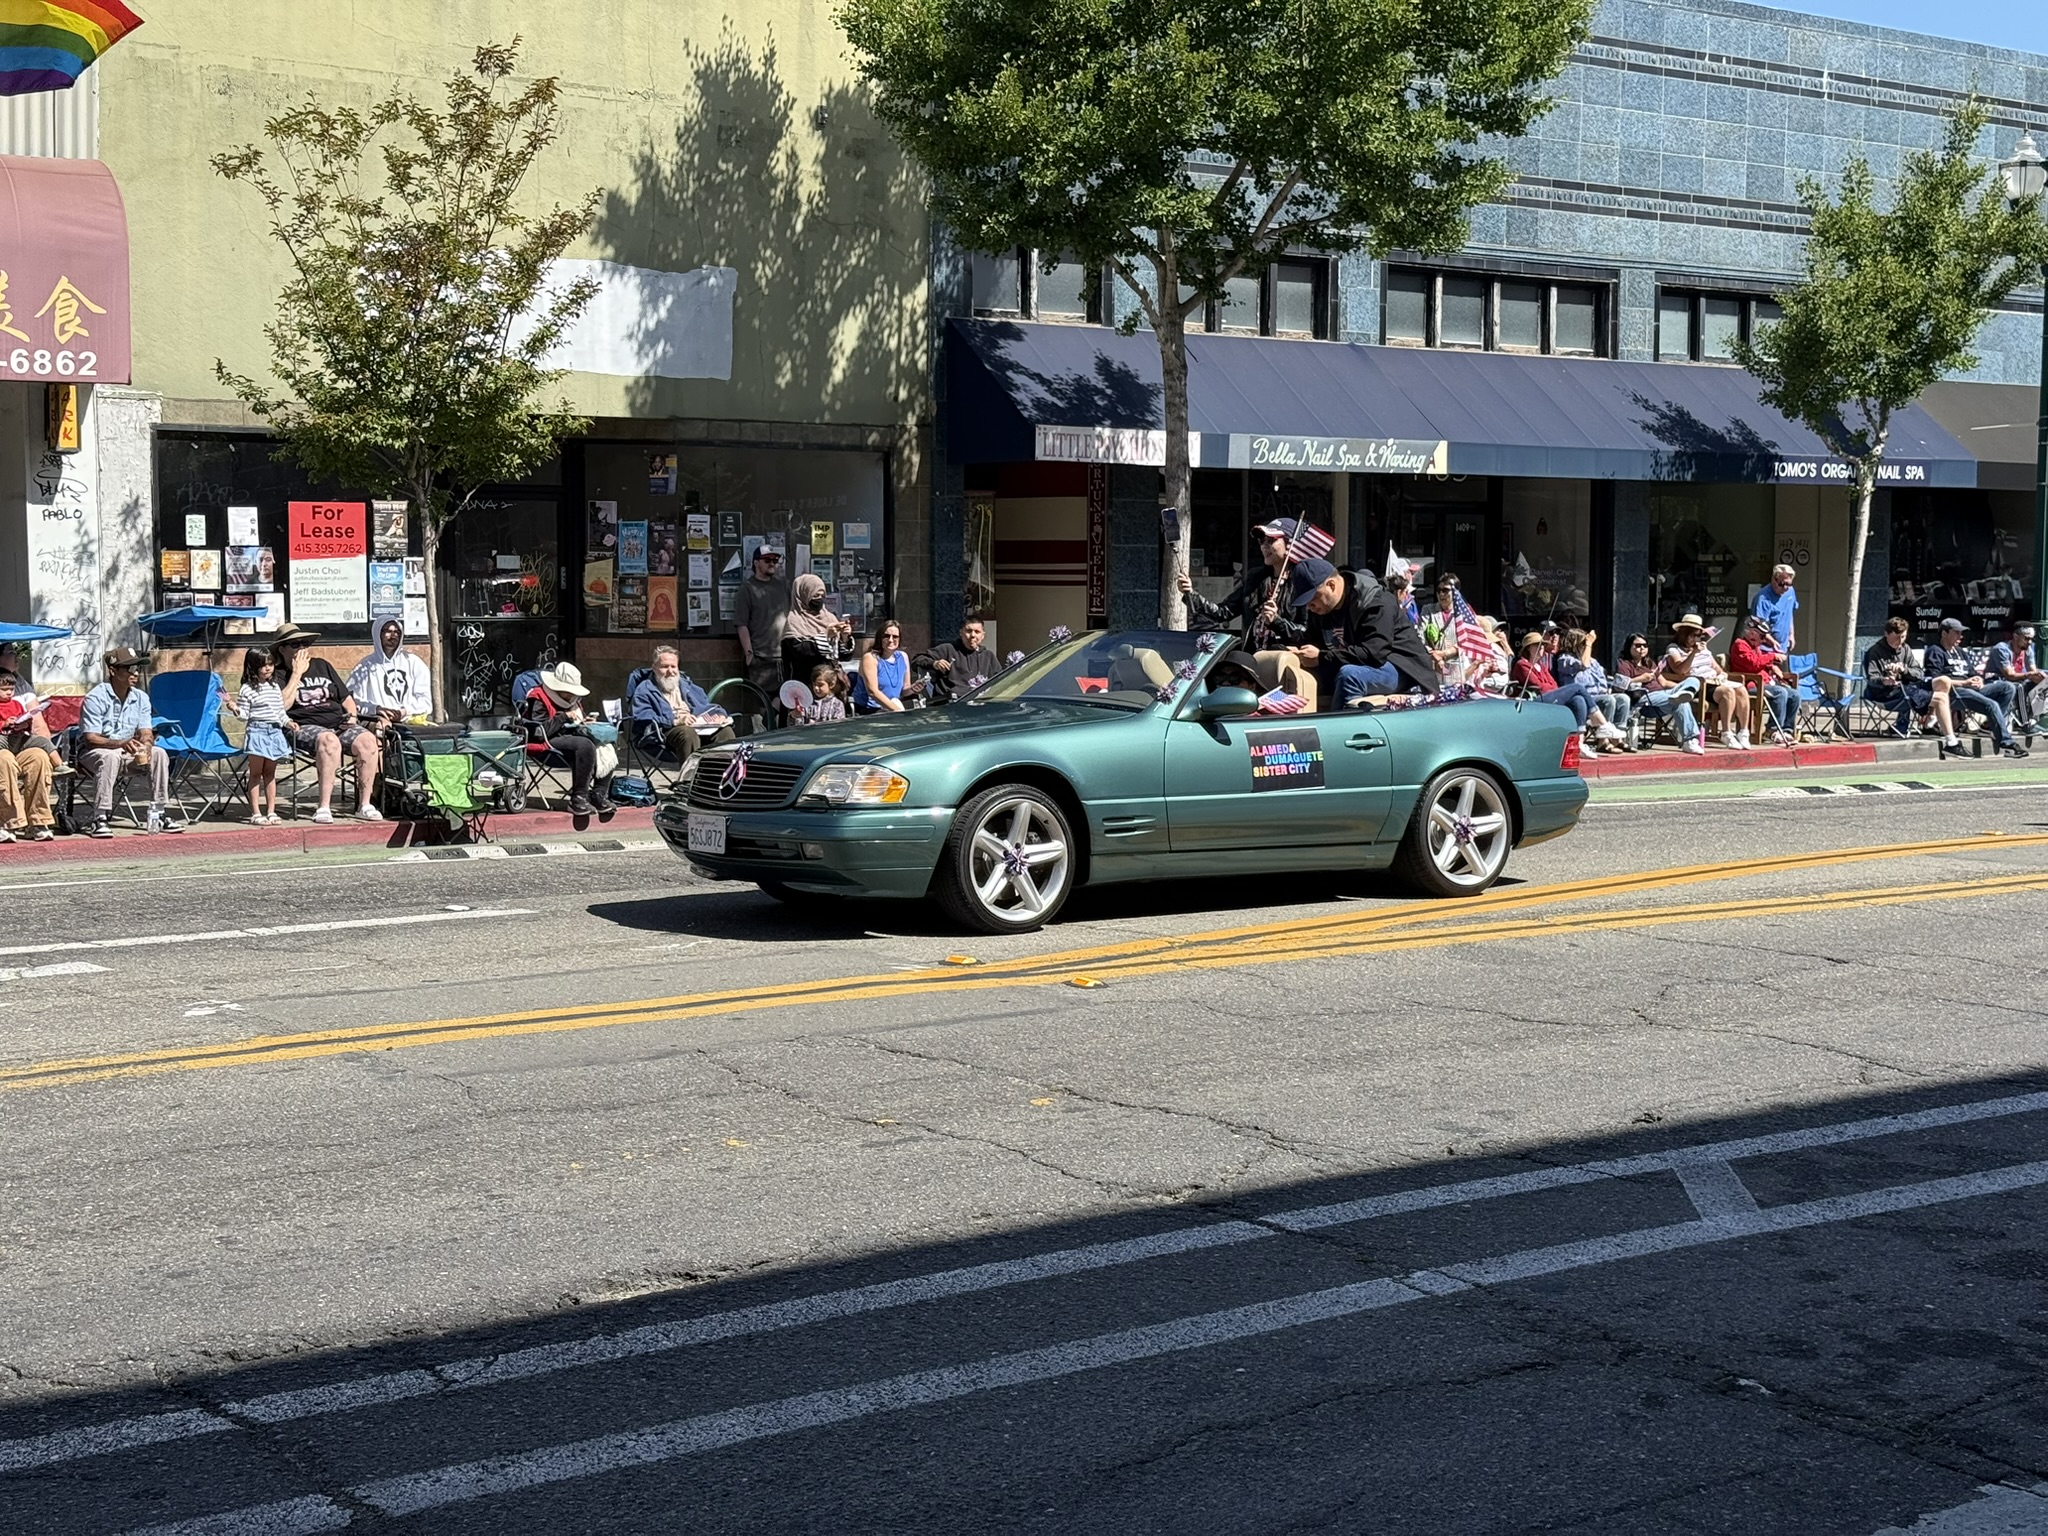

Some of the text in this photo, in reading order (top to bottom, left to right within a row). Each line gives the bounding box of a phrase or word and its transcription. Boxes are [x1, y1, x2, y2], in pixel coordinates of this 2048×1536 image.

[1042, 431, 1092, 459] LITTLE
[1252, 437, 1427, 473] Bella Nail Spa & Waxing
[1774, 461, 1925, 480] TOMO'S ORGA NAIL SPA
[42, 508, 83, 521] PABLO
[311, 505, 344, 521] For
[300, 522, 355, 539] Lease
[294, 543, 362, 554] 415.395.7262
[294, 566, 341, 575] Justin Choi
[1092, 545, 1102, 606] TELLER
[353, 612, 364, 620] JLL
[1915, 606, 1942, 618] Sunday
[1971, 605, 2010, 617] Wednesday
[1918, 620, 1939, 630] 10 am
[1982, 619, 1999, 631] 7 pm
[304, 676, 332, 688] NAVY
[1250, 743, 1296, 757] ALAMEDA
[1264, 750, 1324, 766] DUMAGUETE
[1253, 762, 1311, 778] SISTER CITY
